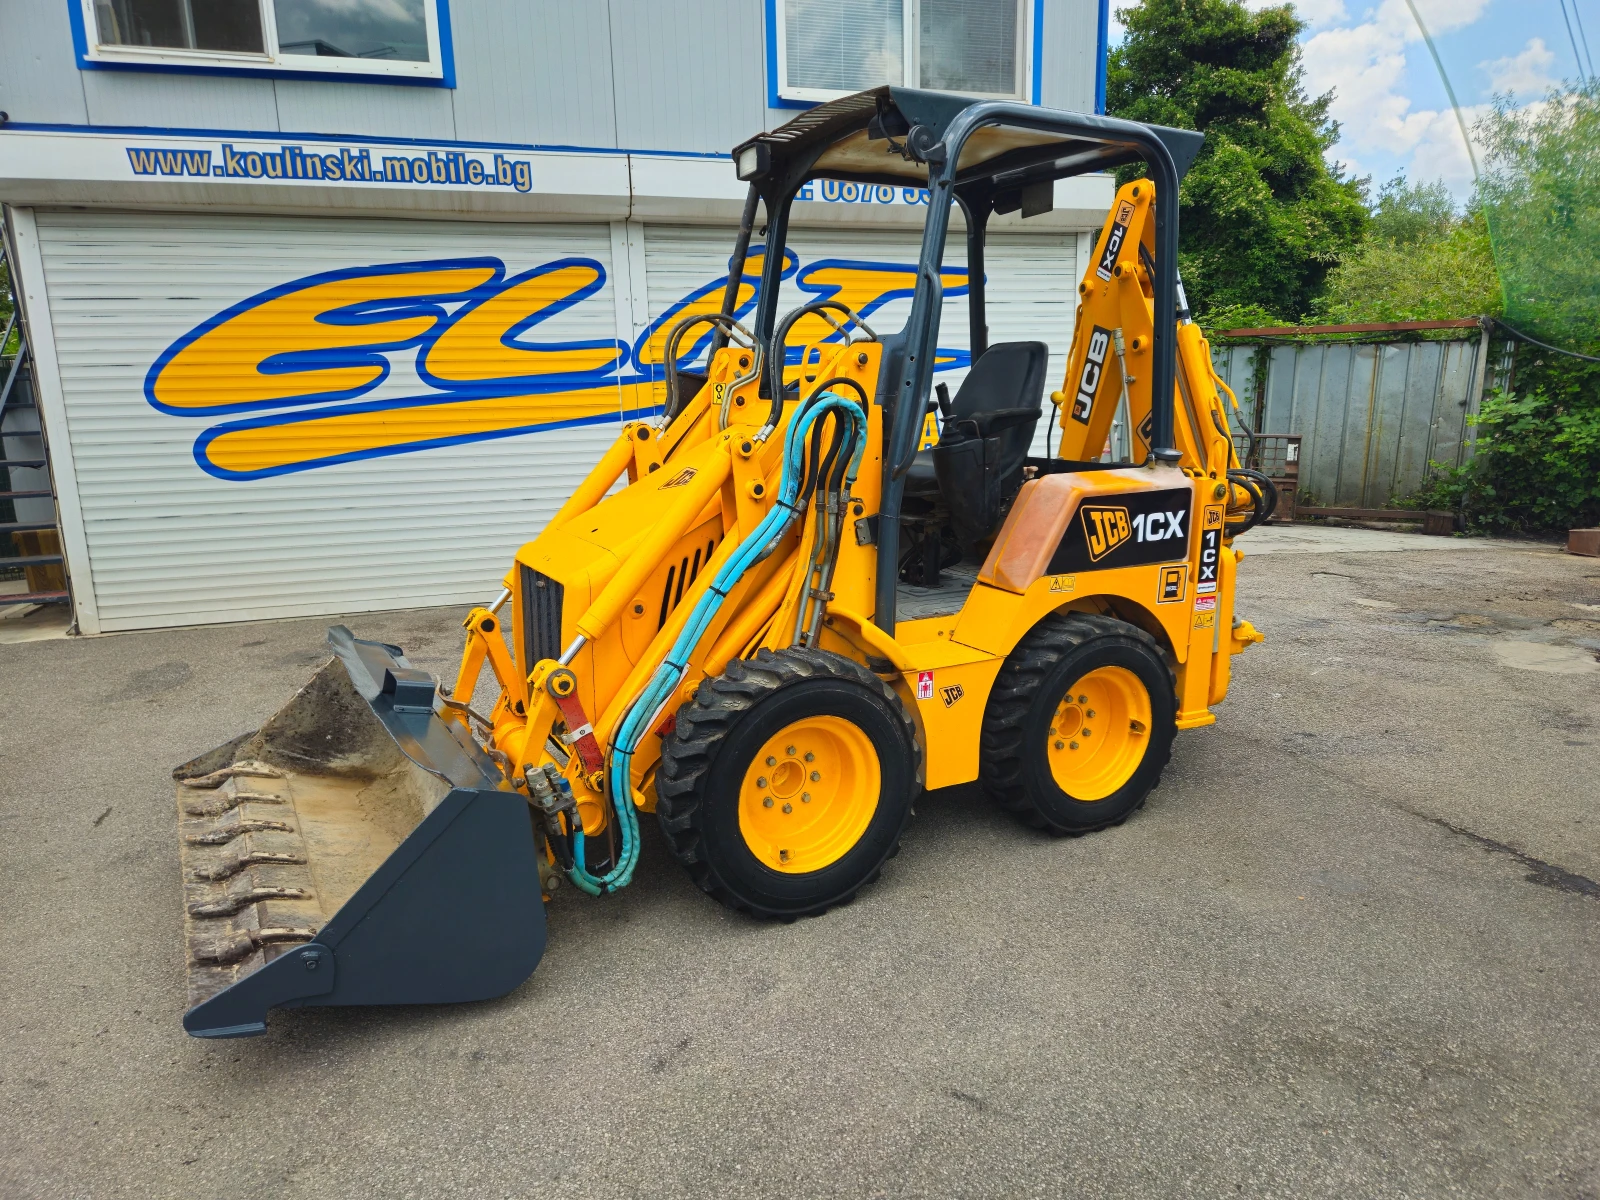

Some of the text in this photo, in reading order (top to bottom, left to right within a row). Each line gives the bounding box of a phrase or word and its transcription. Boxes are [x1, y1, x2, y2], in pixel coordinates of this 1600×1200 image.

[126, 144, 532, 193] www.koulinski.mobile.bg
[1102, 226, 1123, 270] 1CX
[1077, 331, 1109, 419] JCB
[1088, 510, 1130, 556] JCB
[1132, 509, 1186, 543] 1CX
[943, 685, 963, 706] JCB
